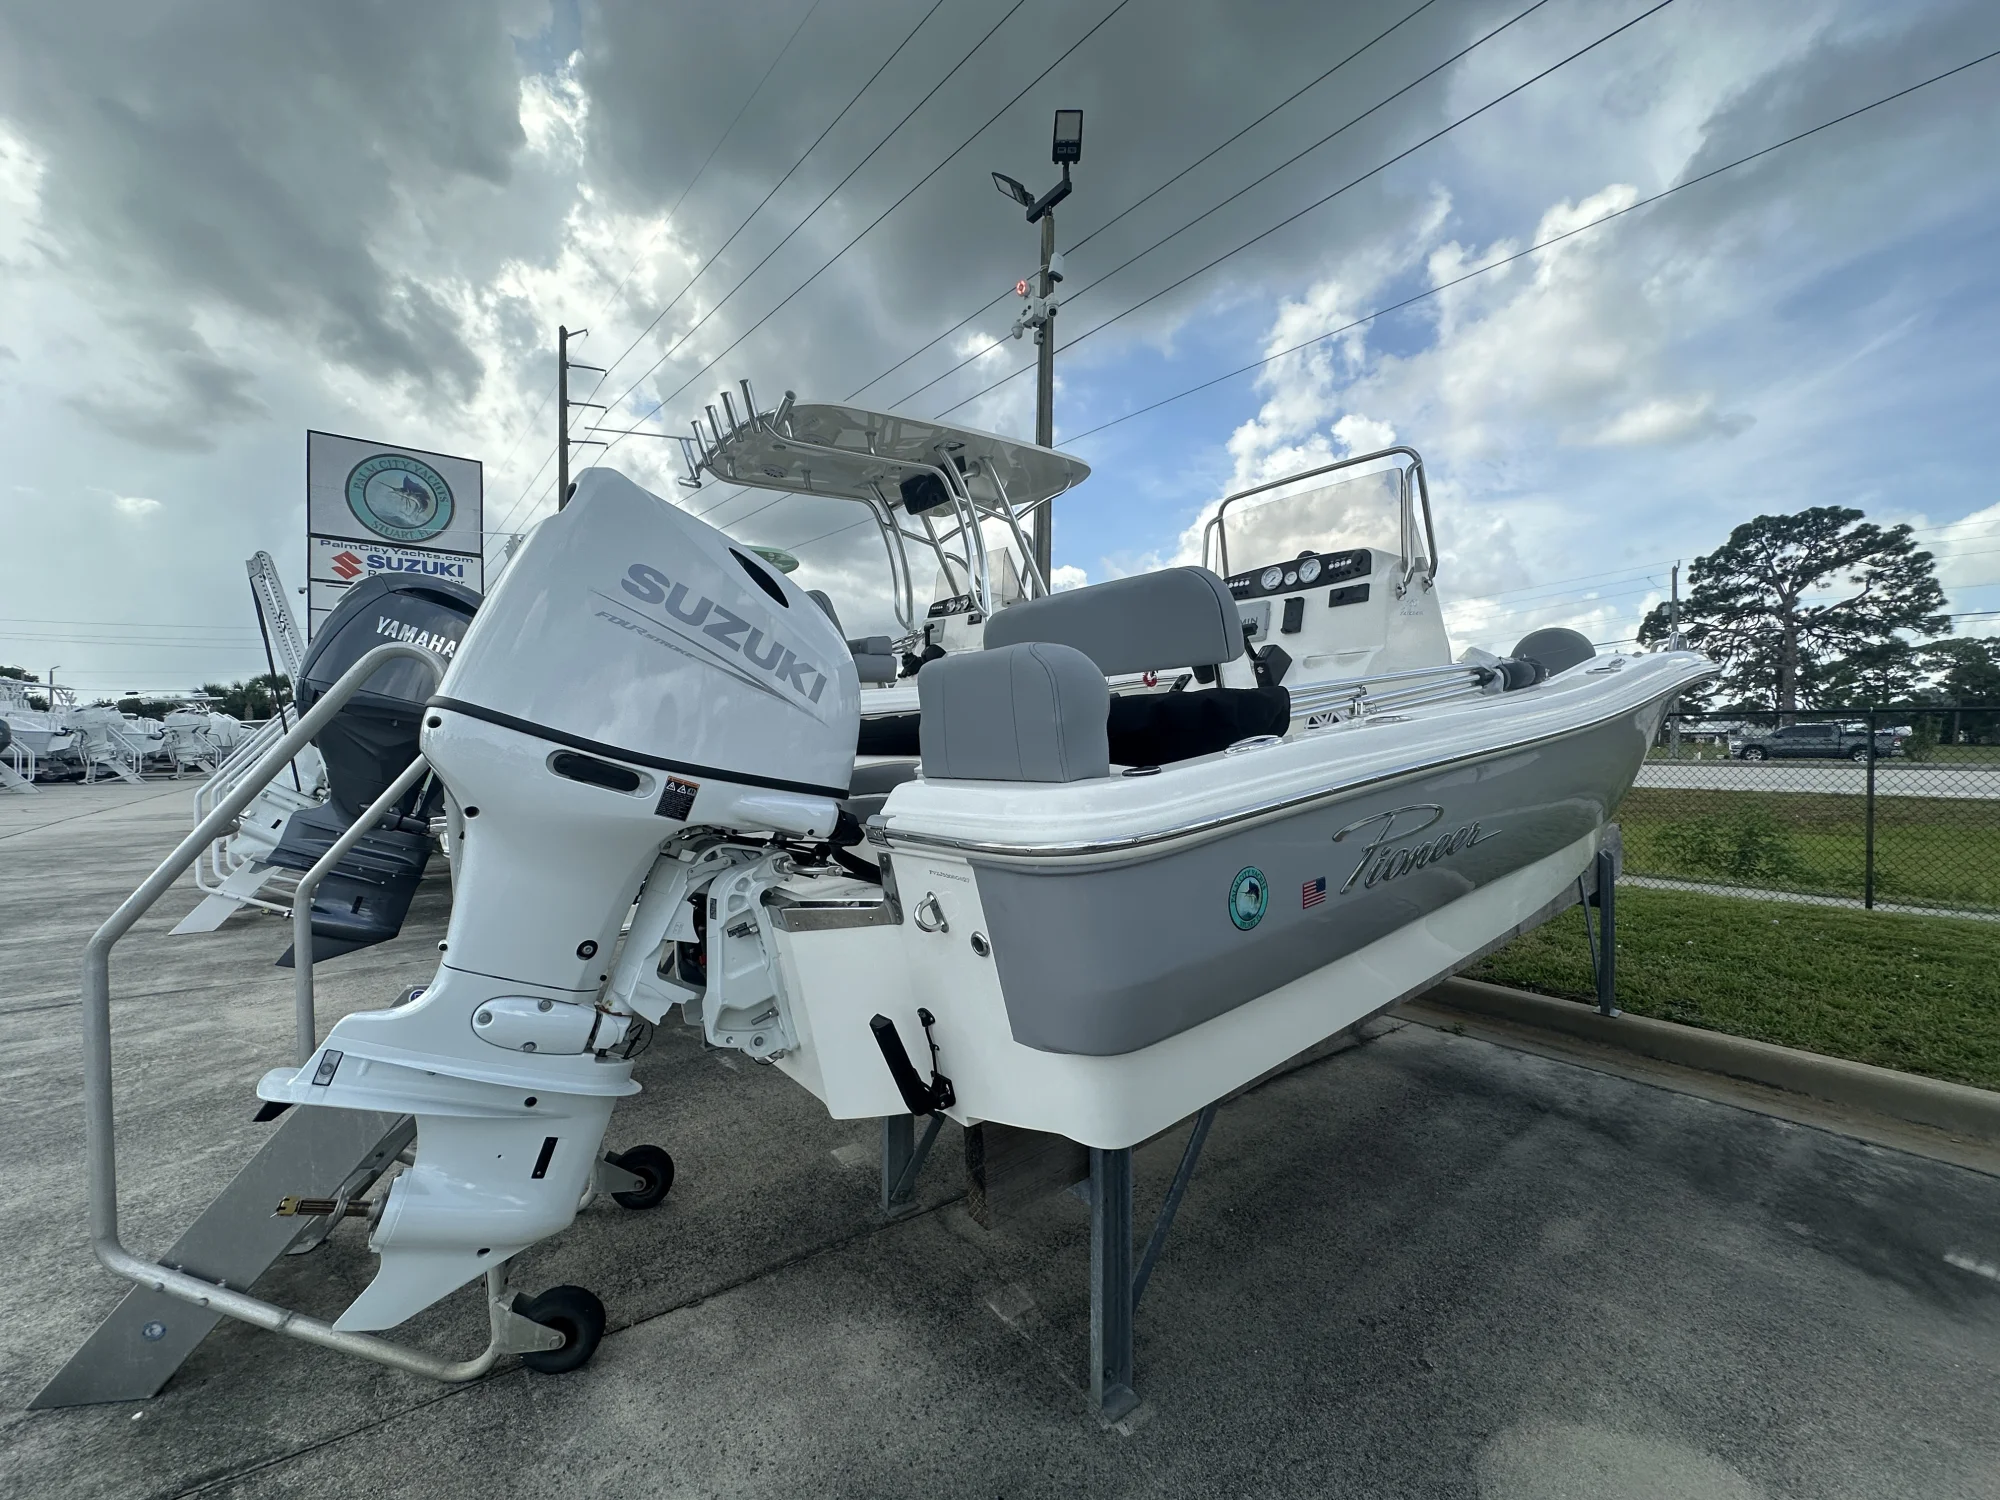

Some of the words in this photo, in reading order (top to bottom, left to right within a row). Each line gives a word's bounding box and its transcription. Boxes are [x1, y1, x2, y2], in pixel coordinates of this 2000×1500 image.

[352, 463, 380, 490] PALM
[379, 460, 413, 471] CITY
[414, 464, 449, 503] YACHTS
[366, 554, 464, 578] SUZUKI
[376, 615, 457, 658] YAMAHA
[594, 611, 648, 636] FOUR
[643, 633, 697, 658] STROKE
[620, 563, 828, 705] SUZUKI
[1332, 803, 1502, 894] Pioneer
